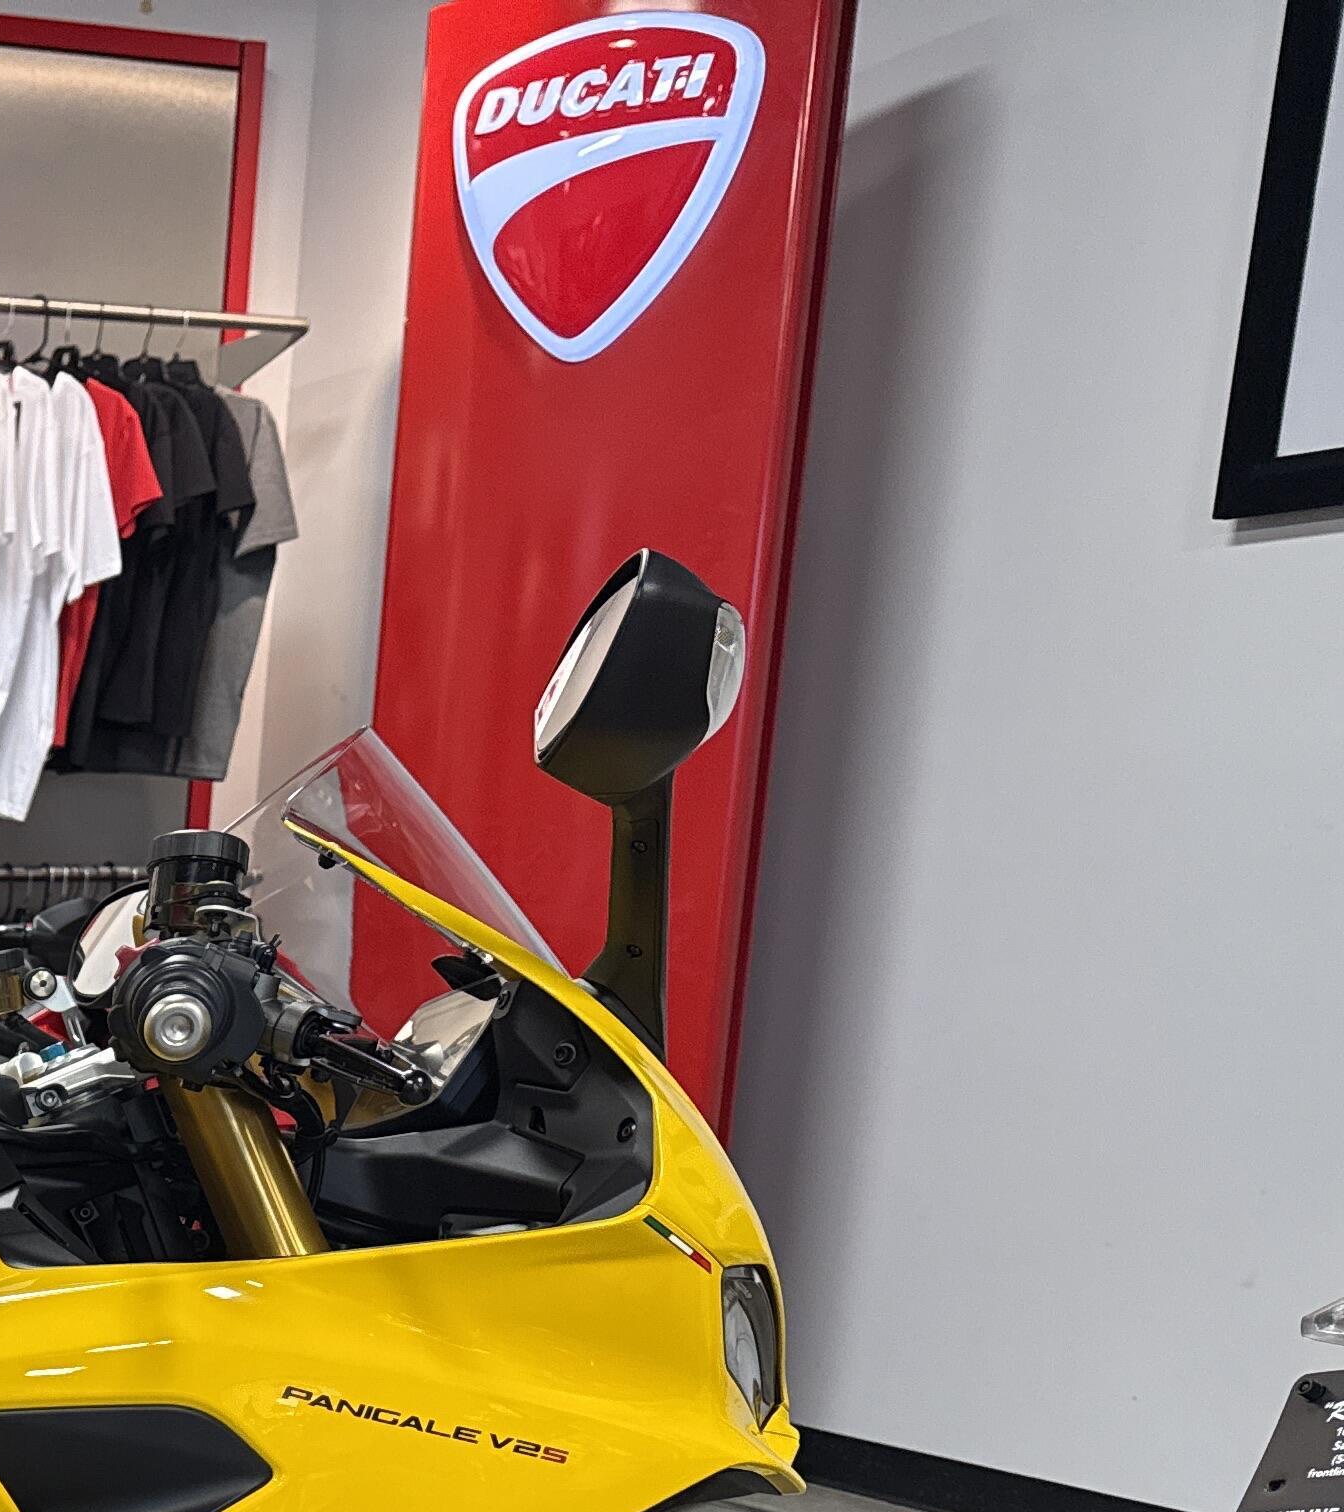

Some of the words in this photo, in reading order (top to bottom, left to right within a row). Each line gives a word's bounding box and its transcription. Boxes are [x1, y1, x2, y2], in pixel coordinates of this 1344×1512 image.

[474, 53, 714, 135] DUCATI
[281, 1385, 481, 1444] PANIGALE
[490, 1433, 570, 1464] V2S
